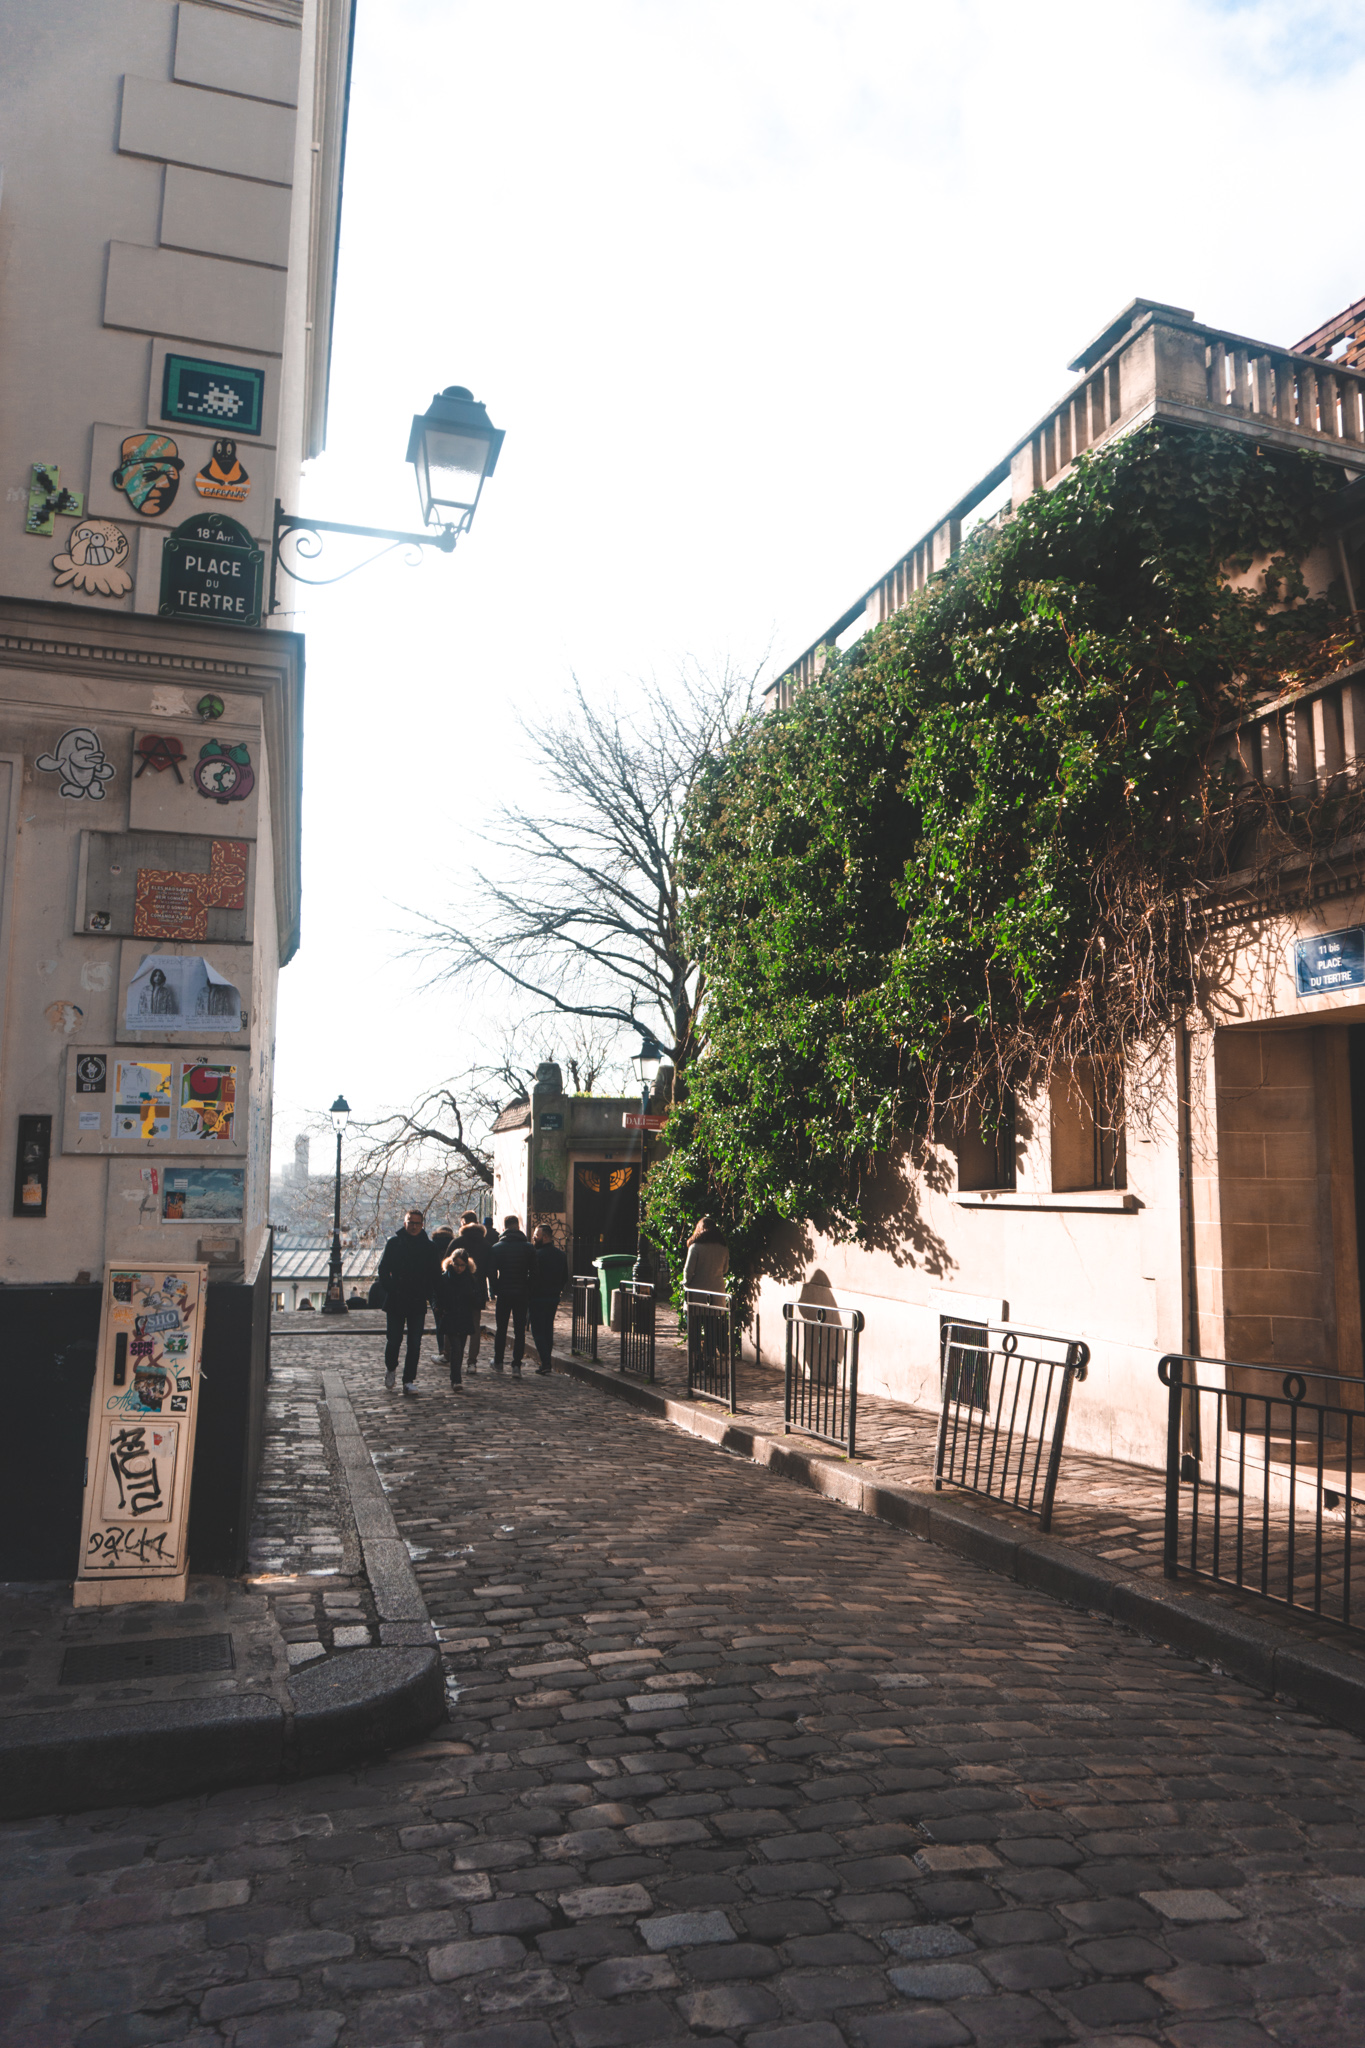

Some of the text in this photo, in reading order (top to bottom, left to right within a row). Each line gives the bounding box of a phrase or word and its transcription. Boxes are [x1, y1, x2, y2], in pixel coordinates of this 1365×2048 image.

[185, 555, 241, 577] PLACE
[206, 579, 219, 588] DU
[178, 590, 245, 613] TERTRE
[1318, 942, 1340, 954] 11 bis
[1317, 957, 1342, 970] PLACE
[1310, 971, 1352, 987] DU TERTRE
